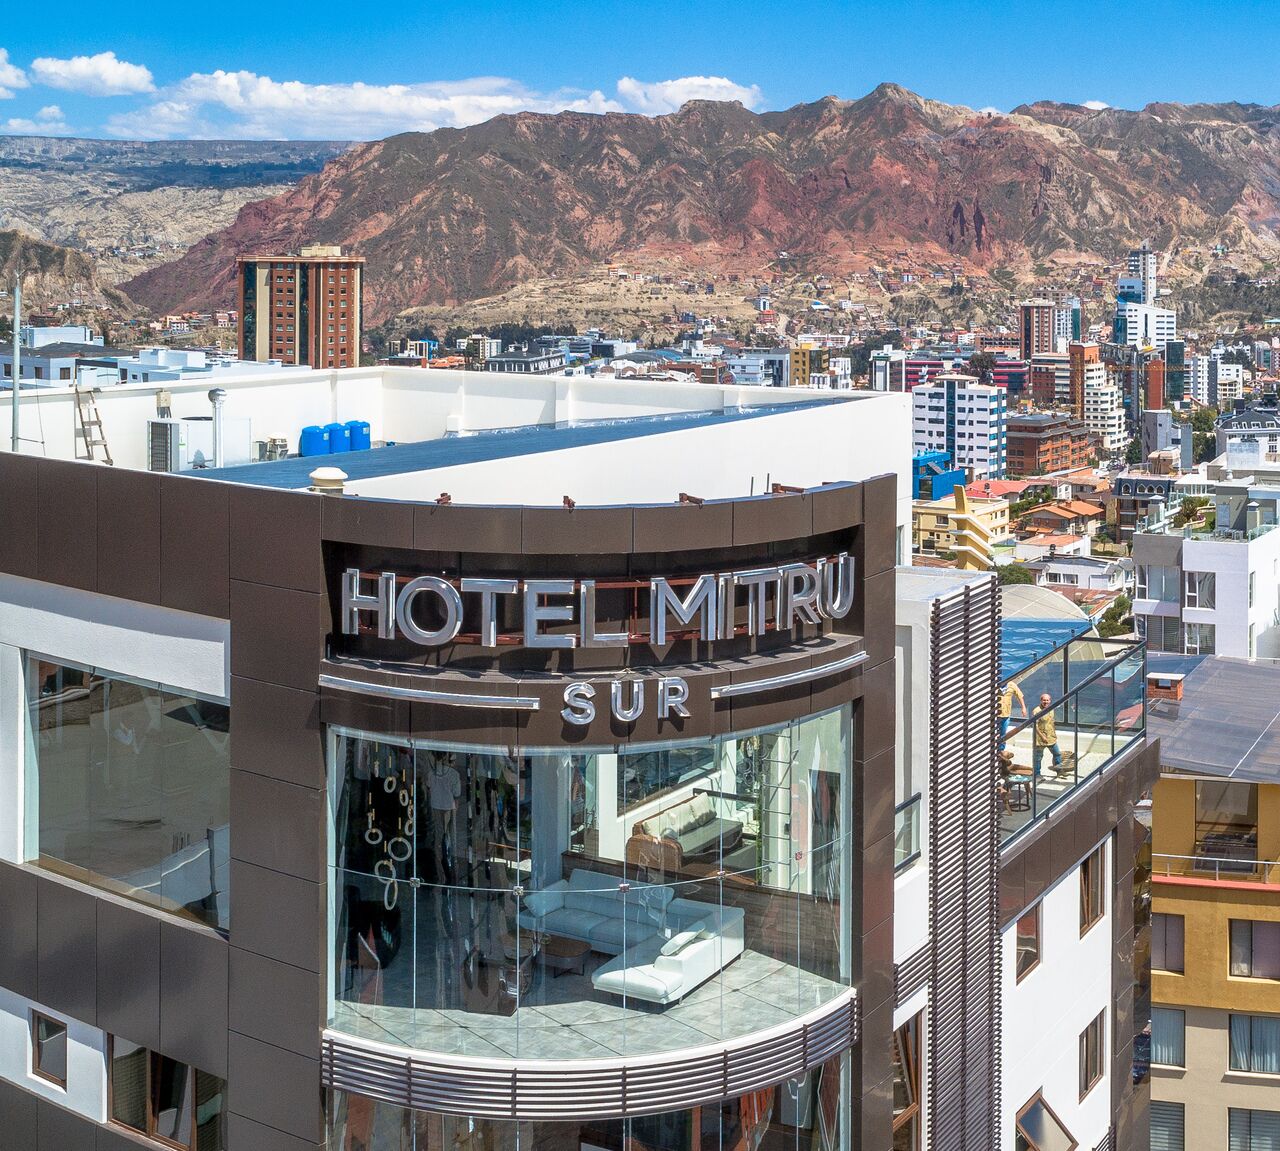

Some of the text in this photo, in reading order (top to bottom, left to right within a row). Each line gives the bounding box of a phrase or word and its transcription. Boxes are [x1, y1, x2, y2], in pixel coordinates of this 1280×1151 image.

[342, 552, 855, 648] HOTEL MITRU
[560, 676, 692, 726] SUR
